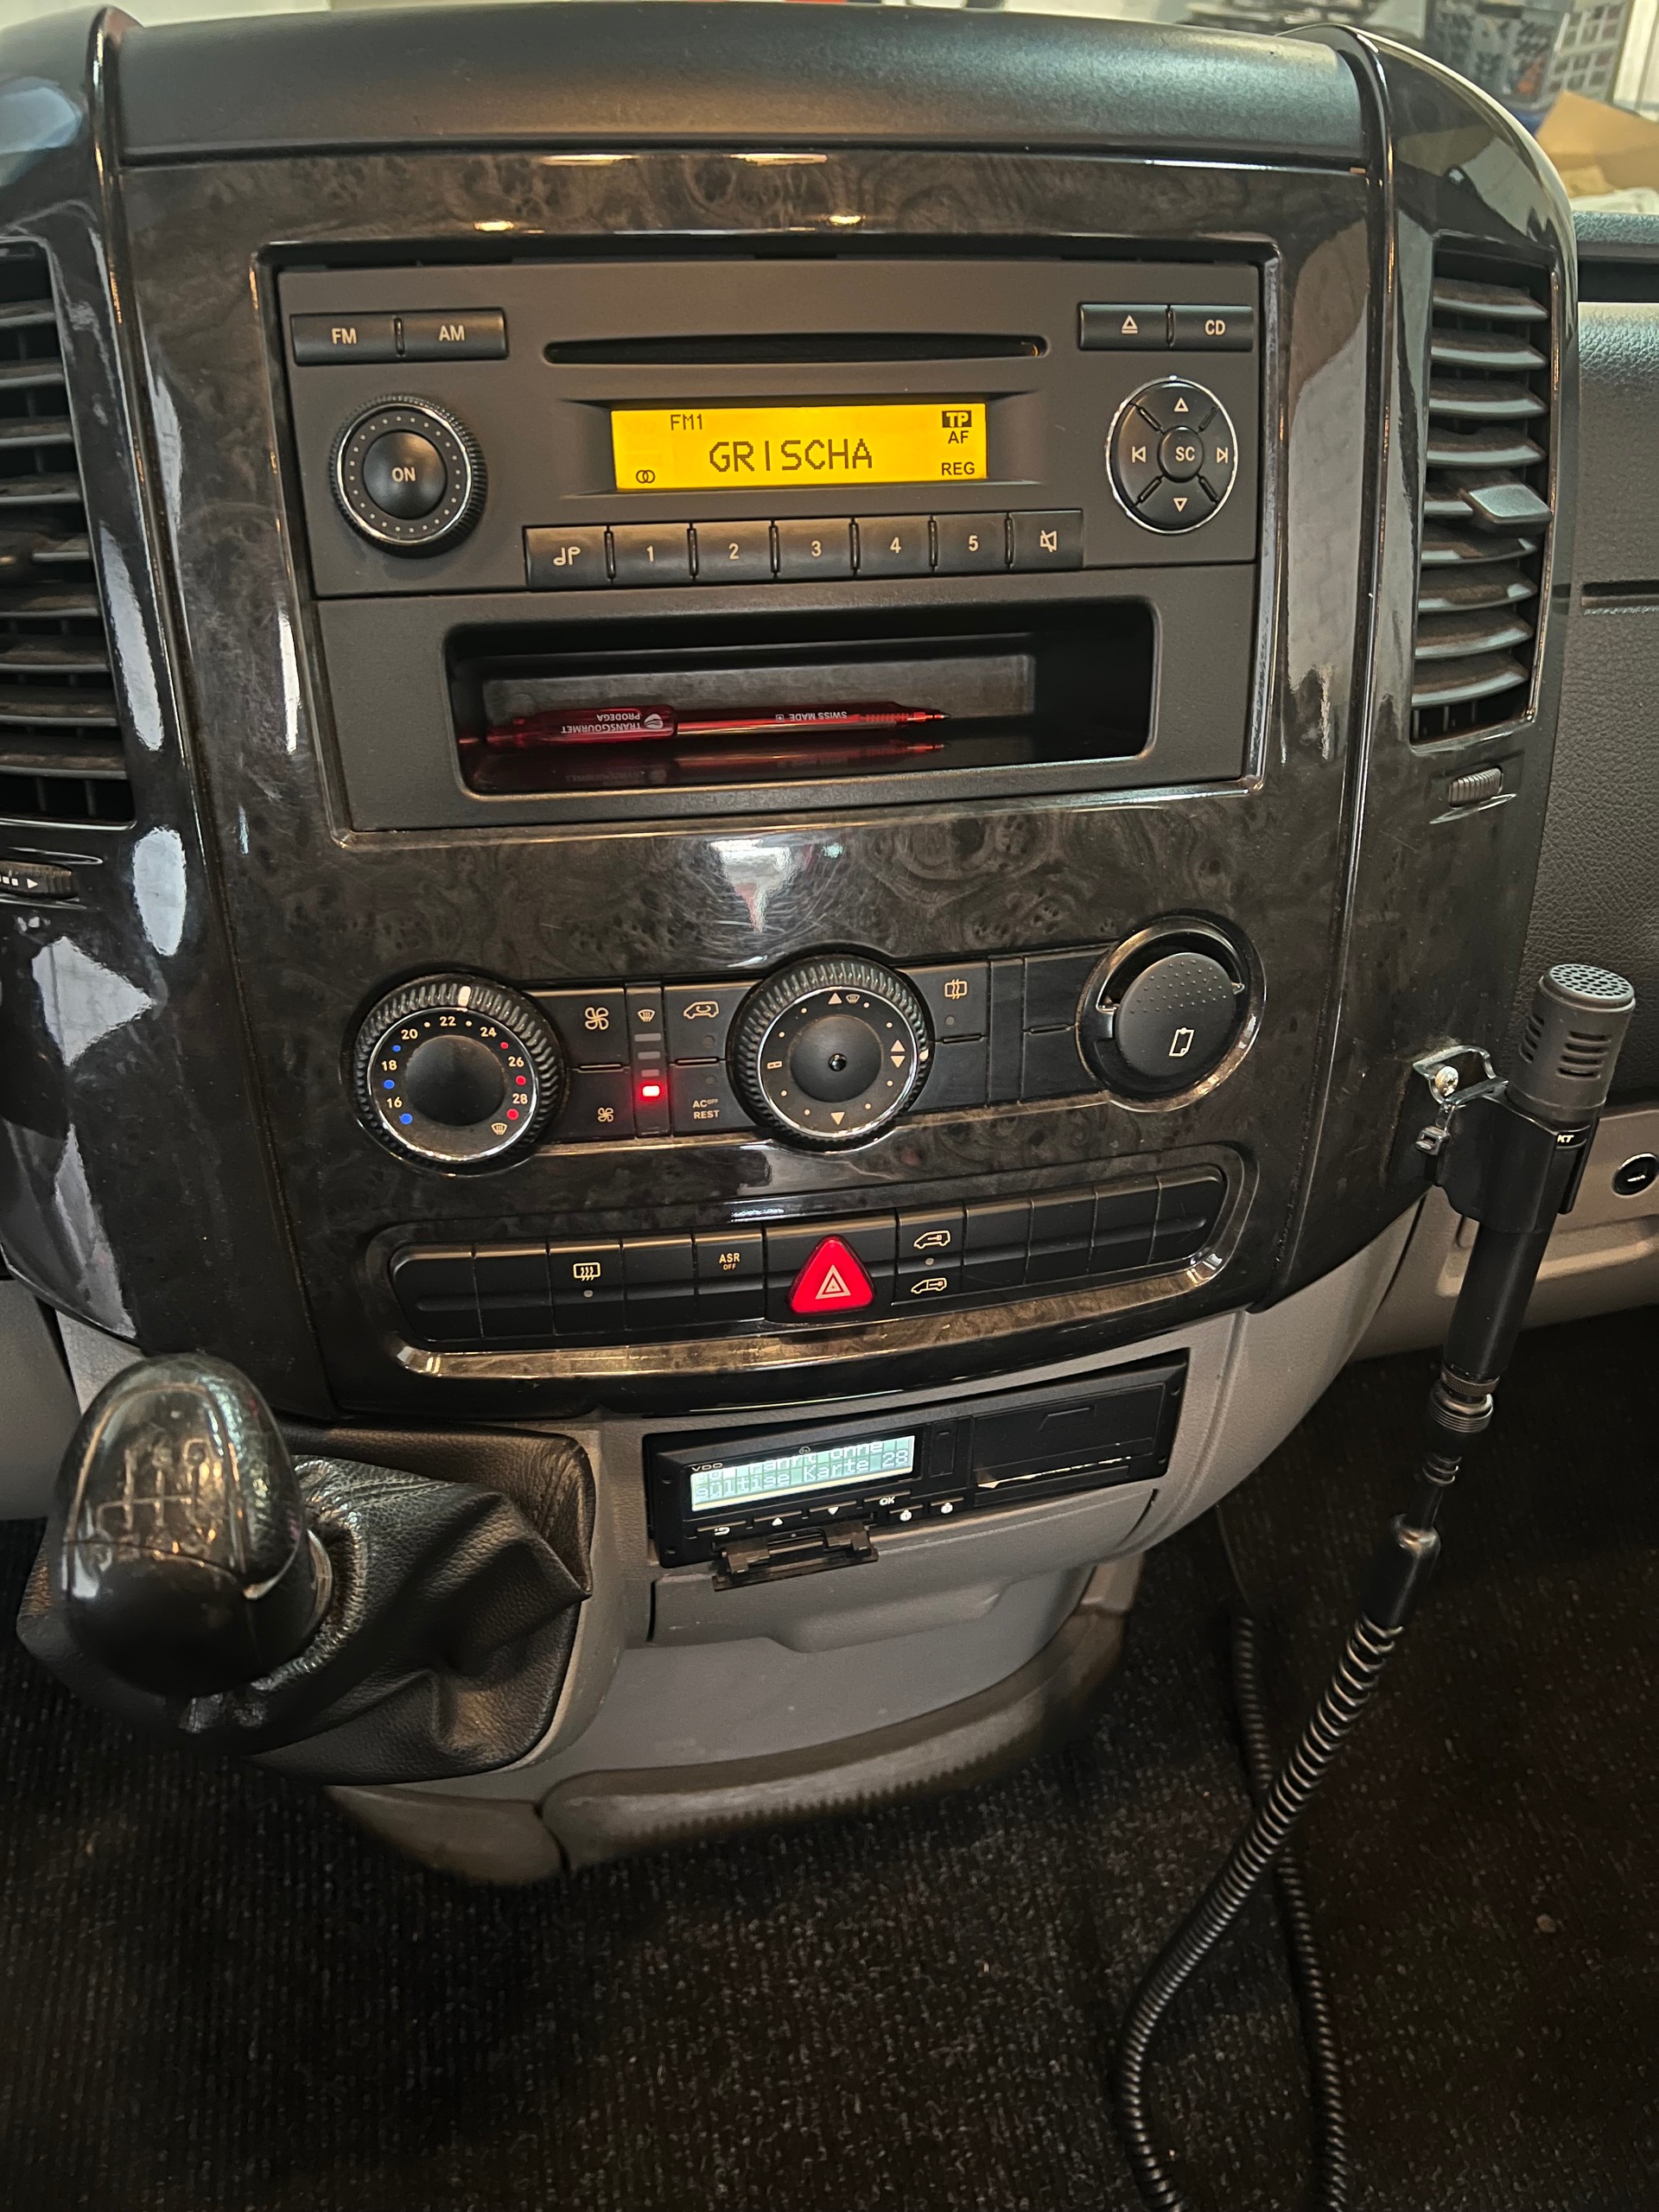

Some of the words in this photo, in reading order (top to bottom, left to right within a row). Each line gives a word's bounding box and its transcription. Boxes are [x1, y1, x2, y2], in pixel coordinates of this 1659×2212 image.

[438, 325, 465, 341] AM
[1205, 319, 1226, 335] CD
[331, 327, 358, 345] FM
[670, 414, 703, 431] FM1
[944, 410, 970, 428] TP
[947, 430, 969, 444] AF
[709, 438, 874, 473] GRISCHA
[1175, 446, 1196, 462] SC
[391, 466, 416, 483] ON
[941, 461, 976, 476] REG
[810, 541, 823, 557] 3
[889, 537, 902, 554] 4
[968, 535, 980, 551] 5
[646, 545, 655, 563] 1
[728, 543, 740, 561] 2
[596, 712, 641, 722] PRODEGA
[788, 712, 817, 721] MADE
[817, 711, 848, 721] SWISS
[561, 722, 641, 734] TRANSGOURMET
[439, 1015, 457, 1027] 22
[400, 1028, 419, 1040] 20
[480, 1027, 498, 1038] 24
[381, 1059, 397, 1071] 18
[507, 1056, 525, 1067] 26
[386, 1096, 403, 1109] 16
[512, 1093, 529, 1105] 28
[693, 1109, 721, 1120] REST
[719, 1252, 741, 1264] ASR
[691, 1462, 724, 1472] VDO
[803, 1458, 869, 1482] Karte
[882, 1449, 909, 1469] 28
[879, 1496, 896, 1506] OK
